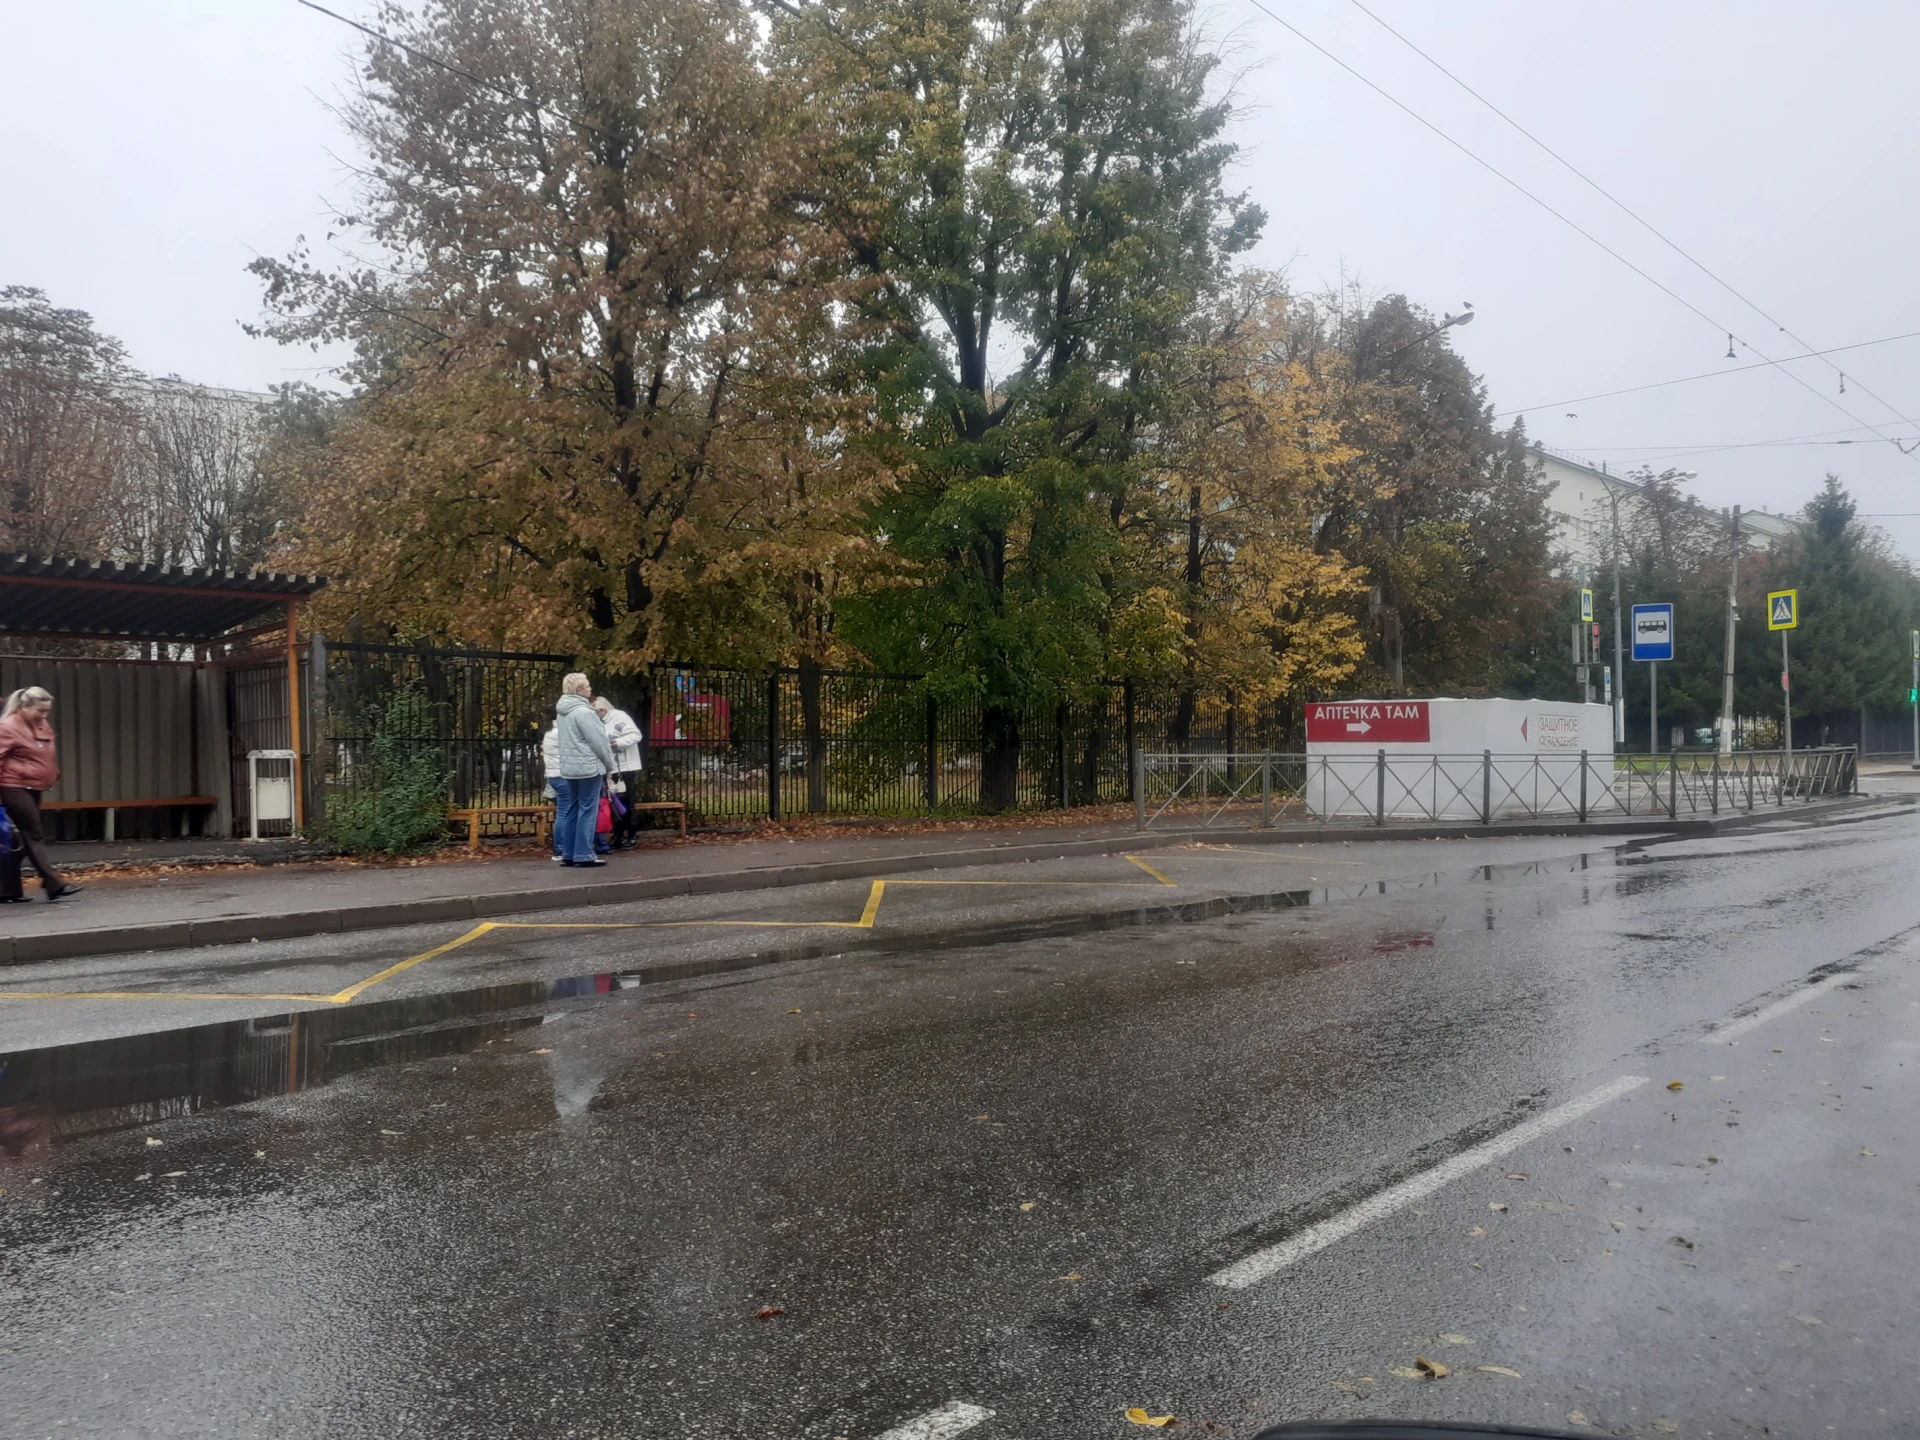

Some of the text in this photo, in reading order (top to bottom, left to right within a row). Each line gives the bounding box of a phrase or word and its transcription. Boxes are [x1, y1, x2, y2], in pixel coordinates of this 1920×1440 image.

[1314, 705, 1420, 720] АПТЕЧКА ТАМ
[1539, 717, 1578, 733] ЗАЩИТНОЕ
[1539, 735, 1578, 747] ОГРАЖДЕНИЕ
